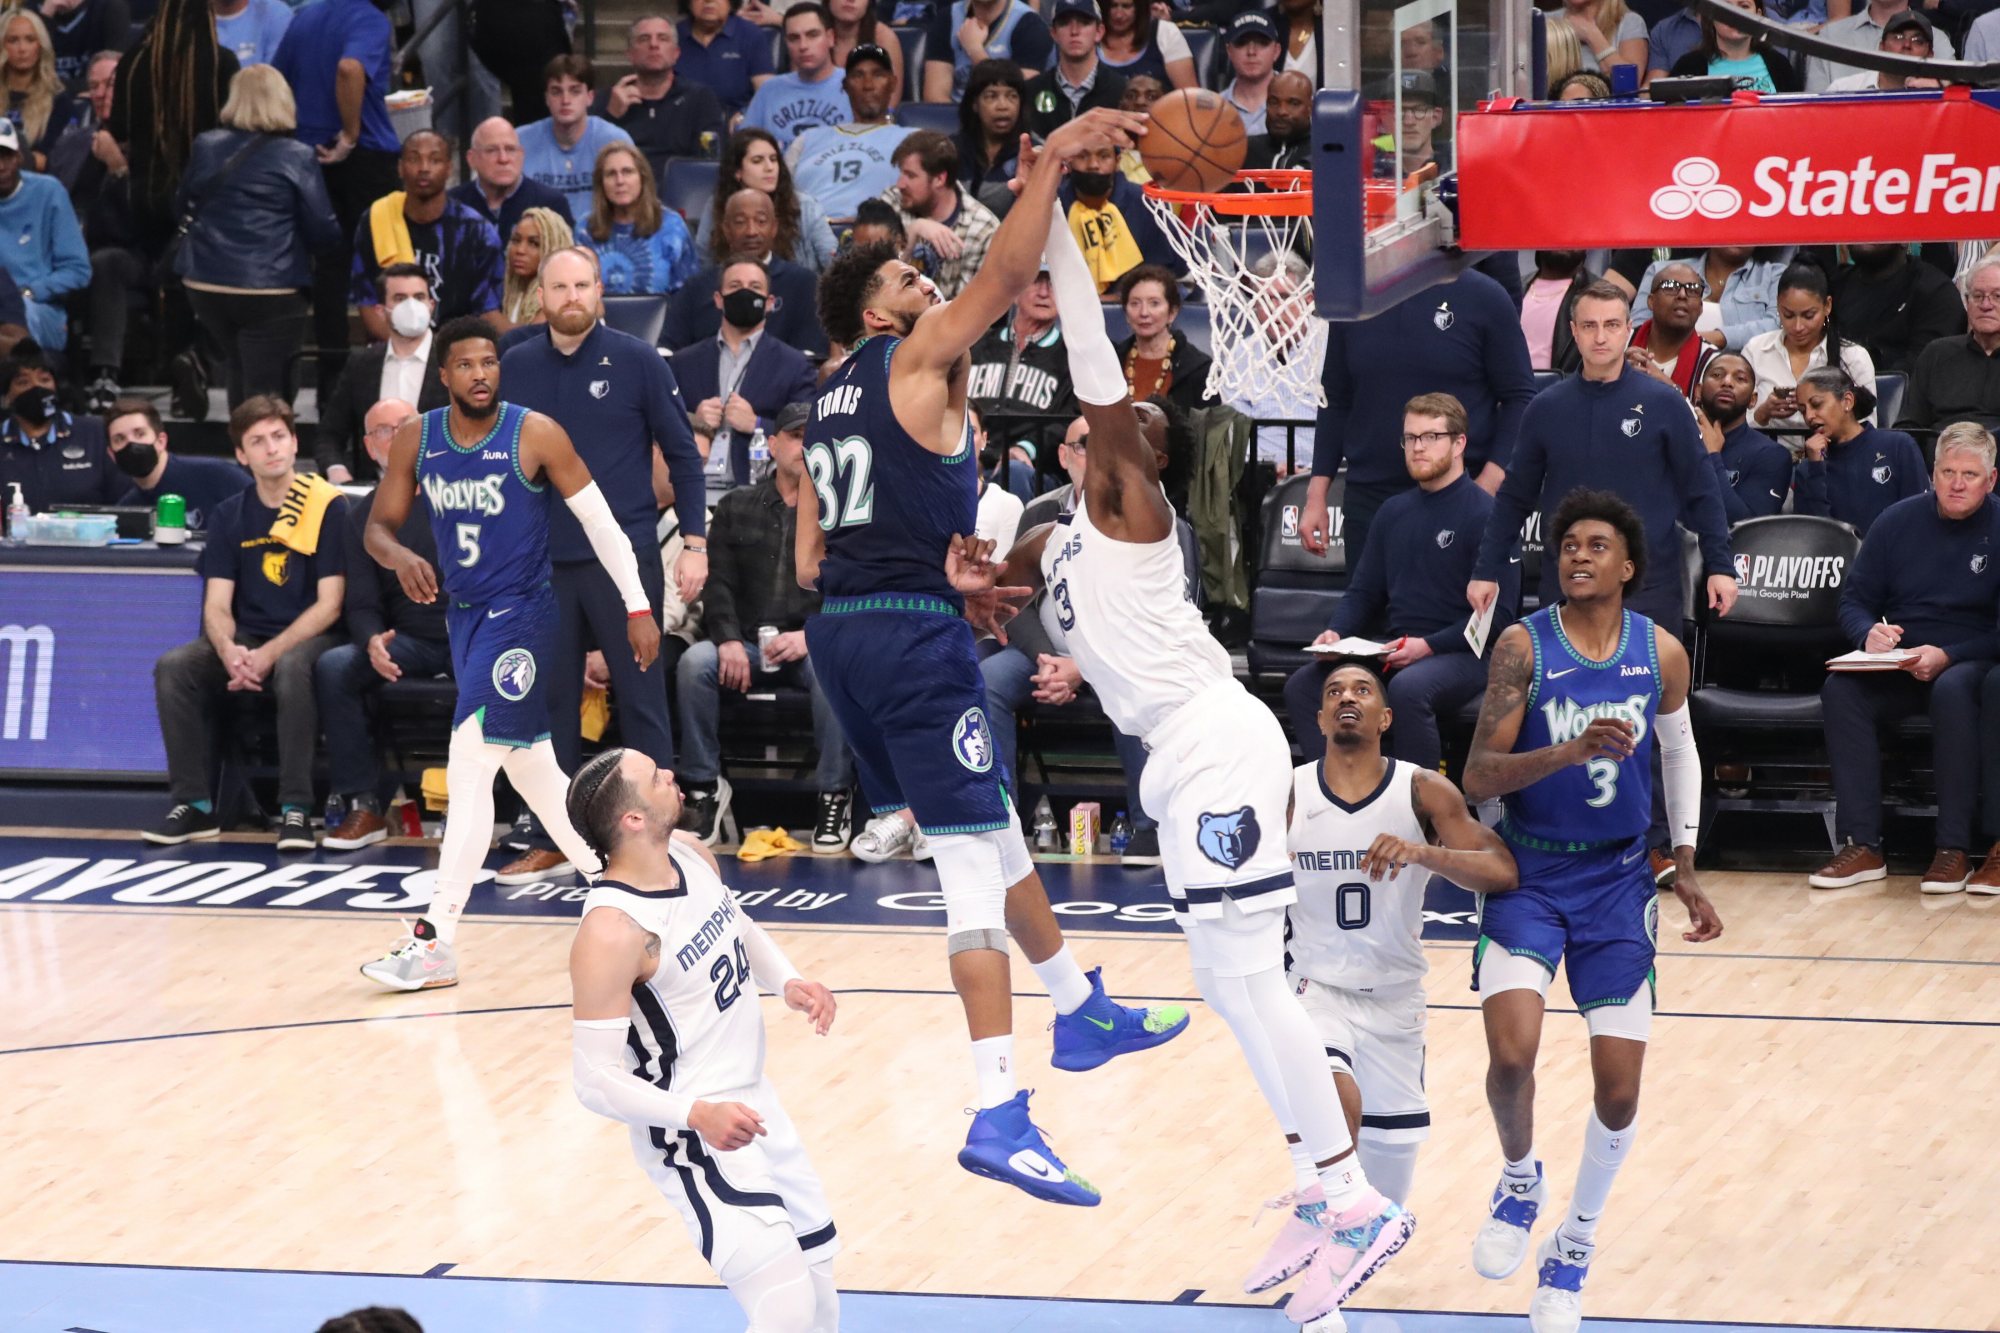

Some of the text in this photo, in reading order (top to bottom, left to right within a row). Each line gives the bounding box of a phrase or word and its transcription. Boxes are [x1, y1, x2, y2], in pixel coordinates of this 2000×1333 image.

[832, 160, 862, 183] 13
[803, 436, 874, 531] 32
[456, 523, 481, 567] 5
[1751, 555, 1845, 588] PLAYOFFS
[1760, 589, 1789, 600] Google
[1791, 590, 1810, 599] Pixel
[1586, 758, 1620, 808] 3
[774, 888, 847, 910] by
[1336, 883, 1370, 930] 0
[710, 936, 750, 1013] 24
